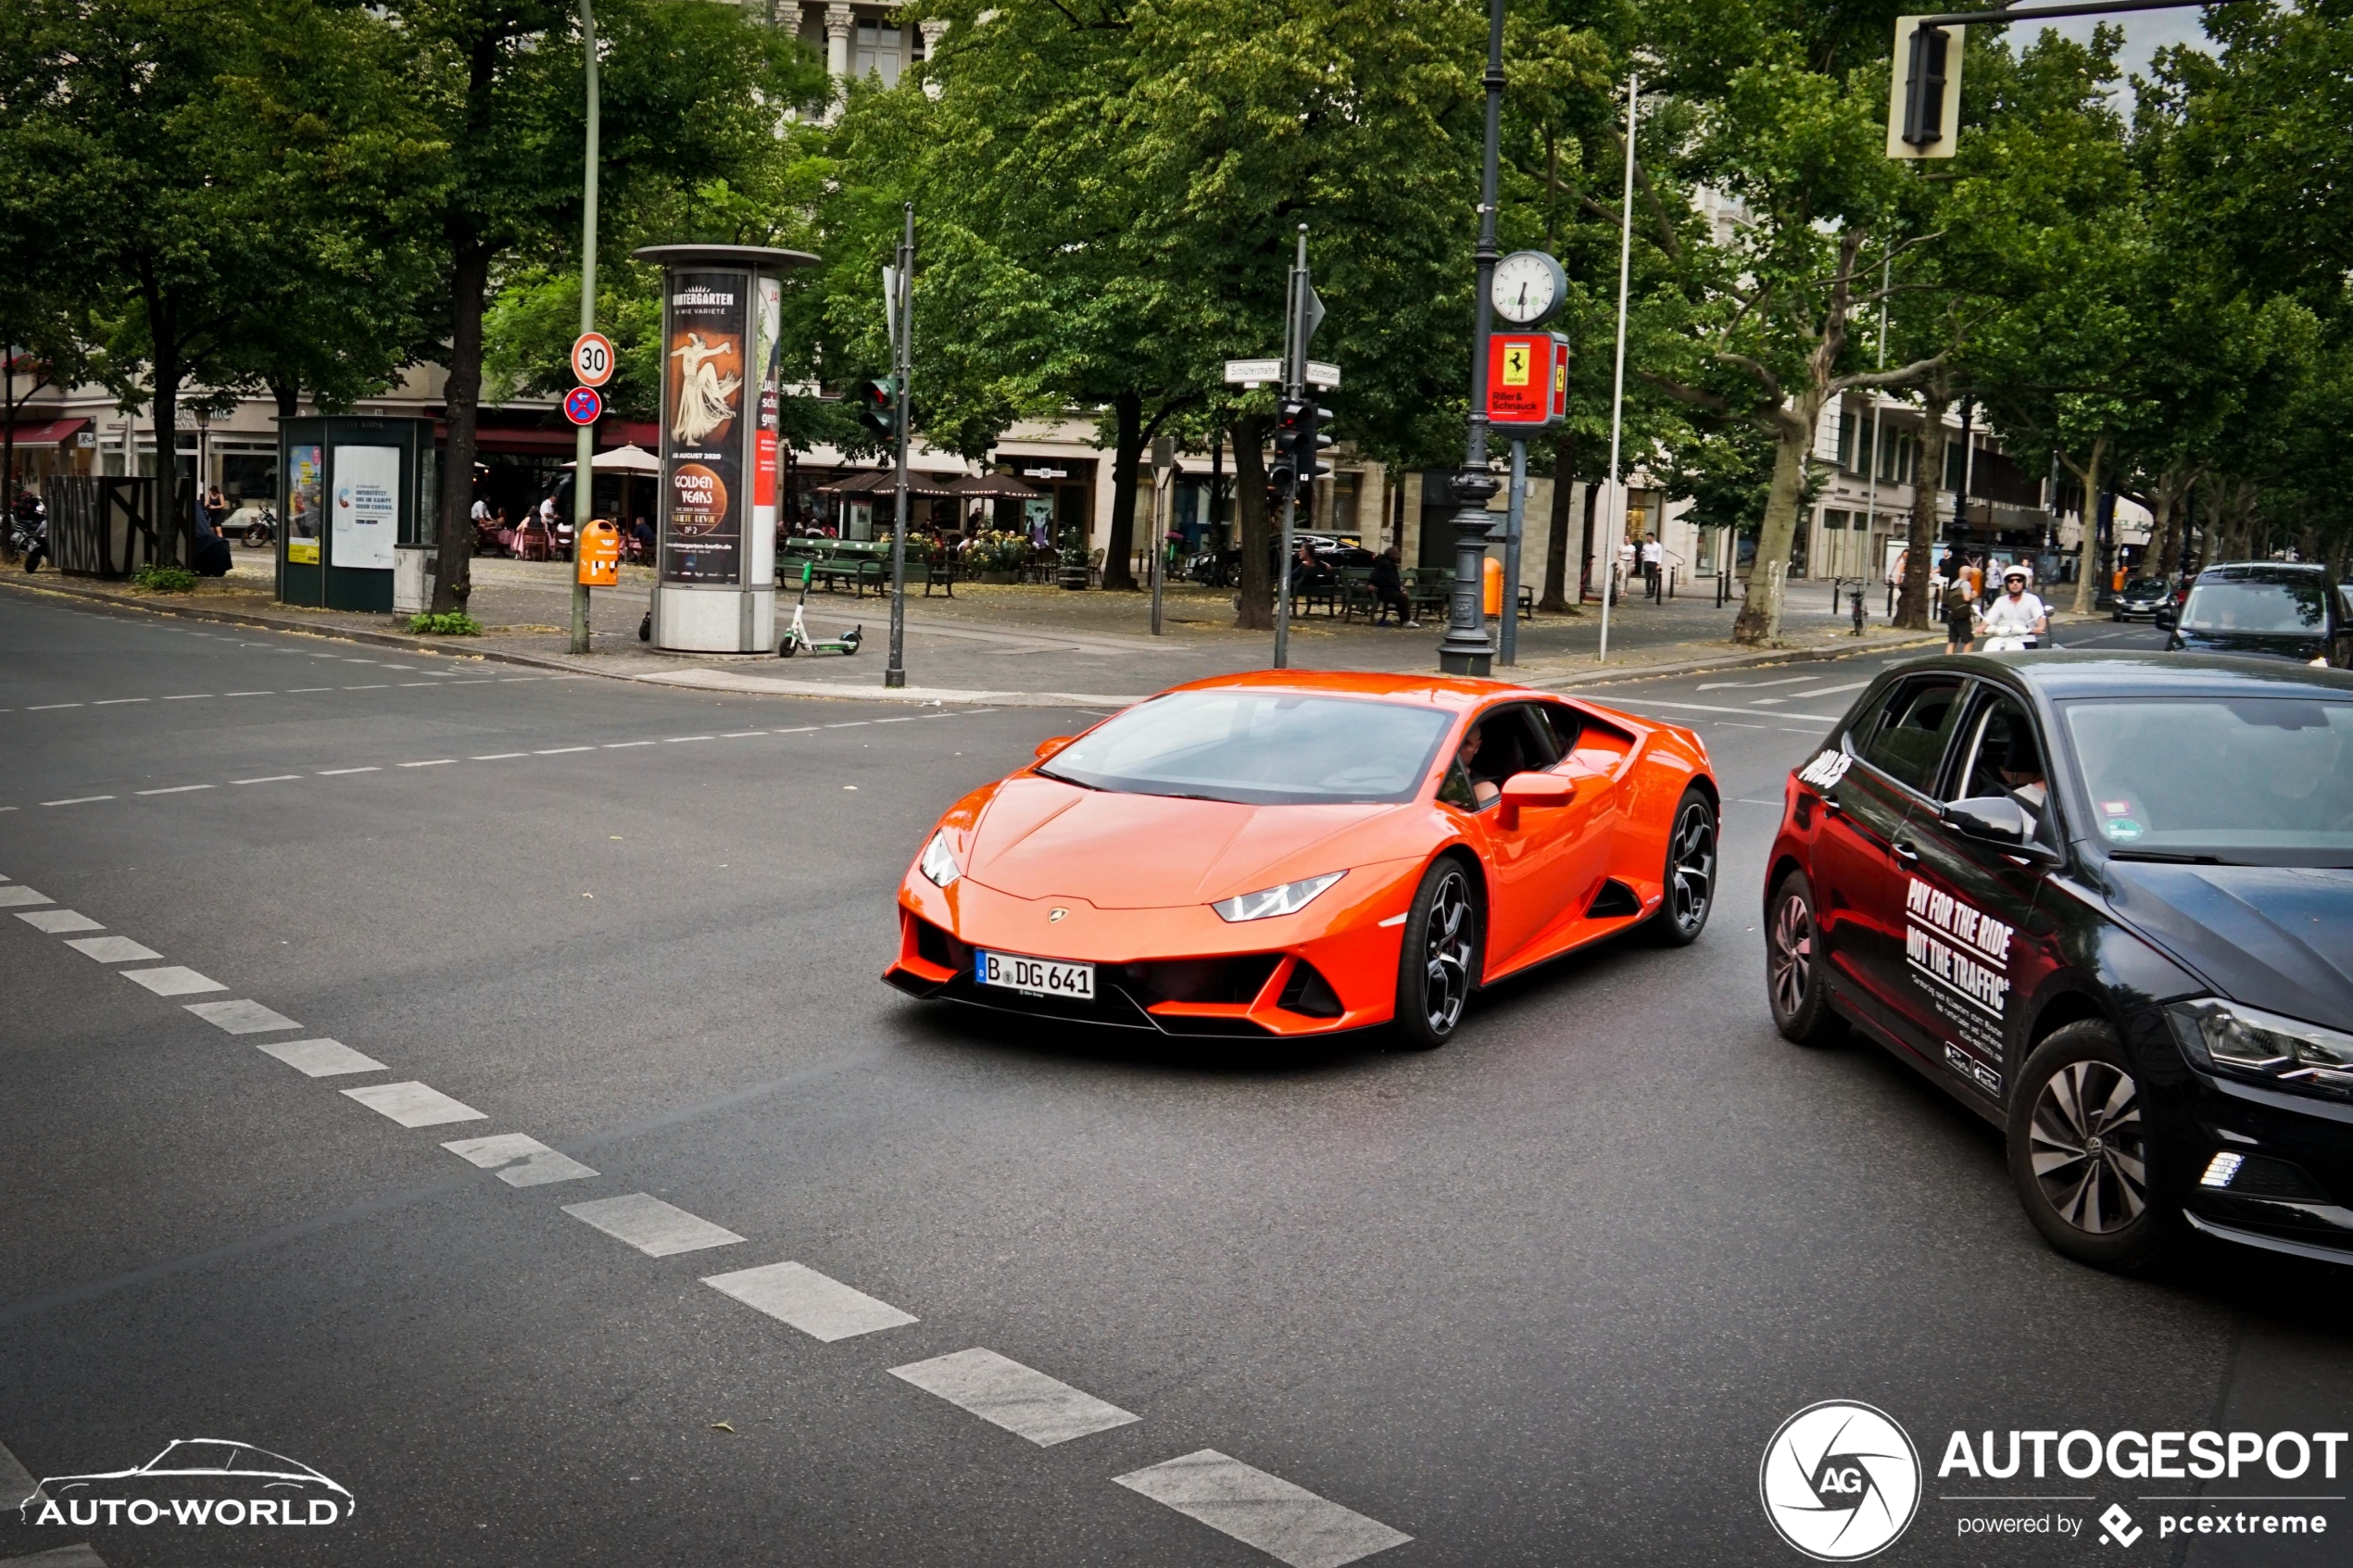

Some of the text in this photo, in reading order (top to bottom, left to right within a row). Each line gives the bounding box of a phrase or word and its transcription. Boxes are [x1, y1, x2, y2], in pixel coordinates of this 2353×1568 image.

[673, 293, 734, 306] WINTERGARTEN
[582, 347, 605, 370] 30
[1231, 365, 1277, 376] Schlüterstraße
[1492, 391, 1522, 400] Riller &
[1492, 401, 1538, 409] Schnauck
[674, 475, 713, 489] GOLDEN
[682, 490, 713, 504] YEARS
[693, 526, 698, 534] 2
[1906, 878, 2014, 960] PAY FOR THE RIDE
[1906, 924, 1929, 964] NOT
[1930, 937, 1952, 980] THE
[978, 969, 985, 977] D
[988, 957, 1091, 994] B DG 641
